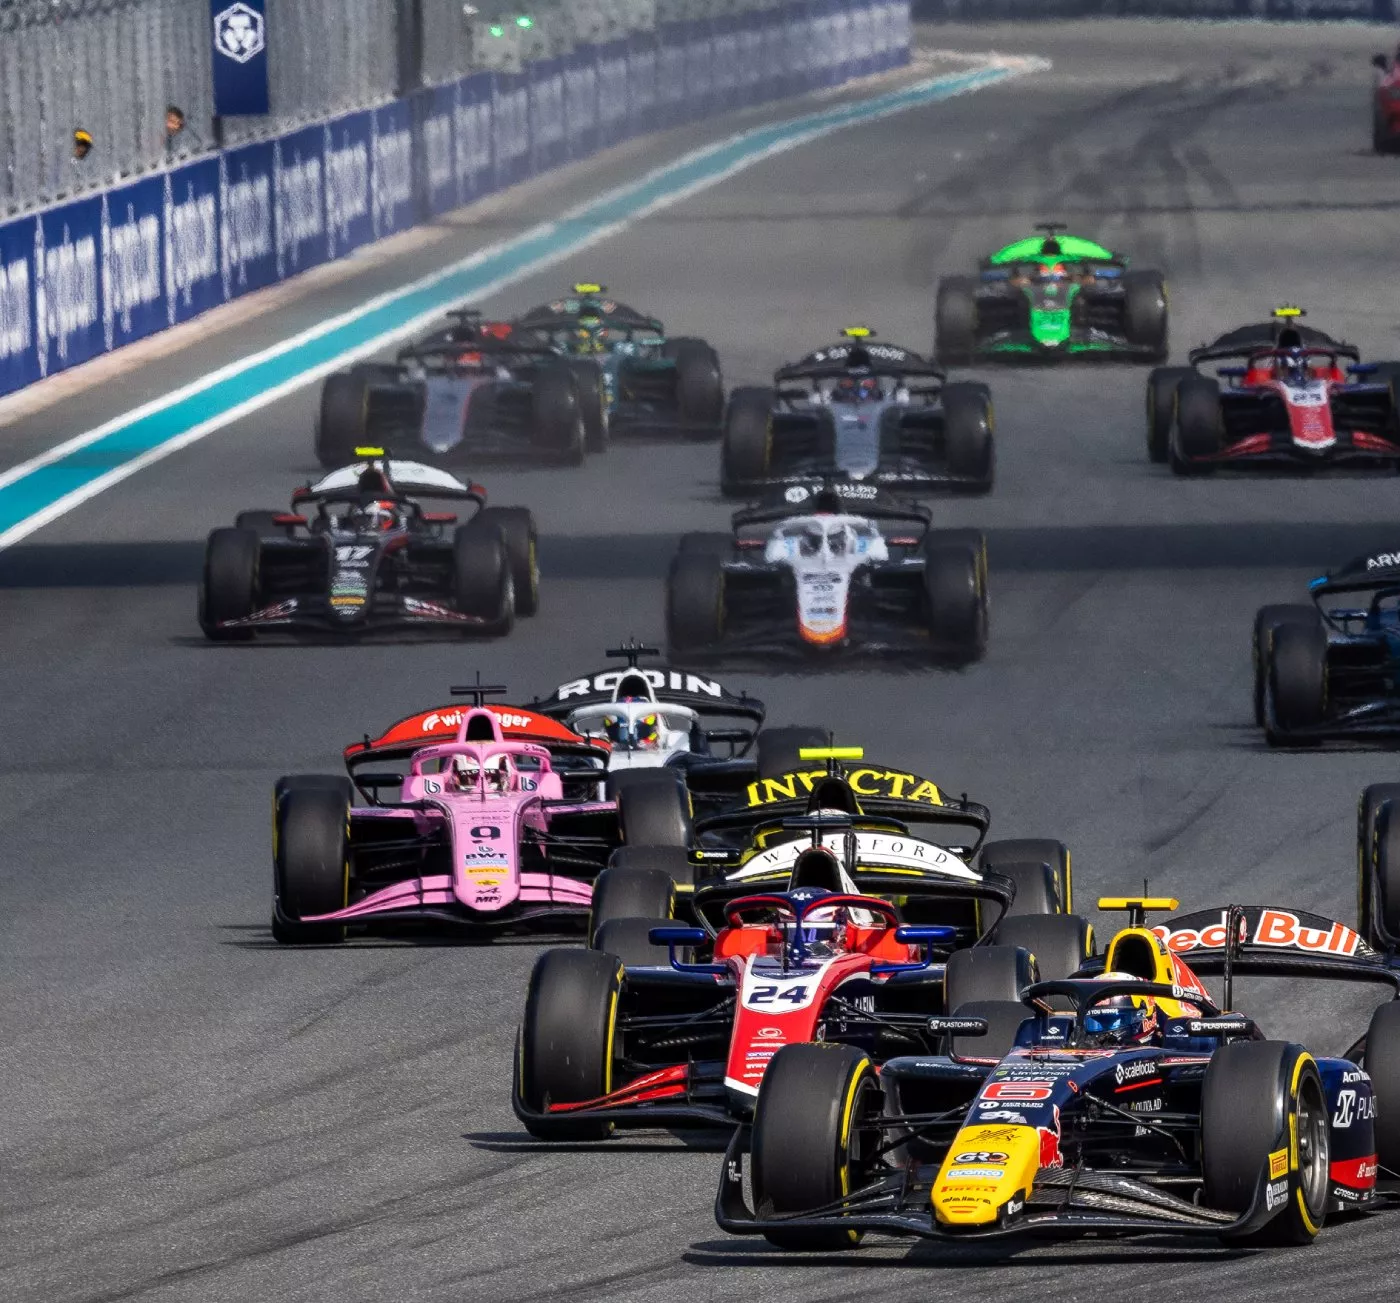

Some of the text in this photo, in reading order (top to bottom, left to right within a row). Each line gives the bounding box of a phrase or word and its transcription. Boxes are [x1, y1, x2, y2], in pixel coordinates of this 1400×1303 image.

[558, 669, 721, 701] RODIN
[747, 769, 943, 807] INVCTA
[470, 826, 501, 843] 9
[763, 838, 947, 864] WAEFORD
[1151, 909, 1360, 956] Red Bull
[748, 985, 809, 1004] 24
[1124, 1061, 1156, 1079] scalefocus
[979, 1081, 1054, 1101] 6
[950, 1169, 1001, 1177] aramco
[942, 1196, 991, 1205] dallara
